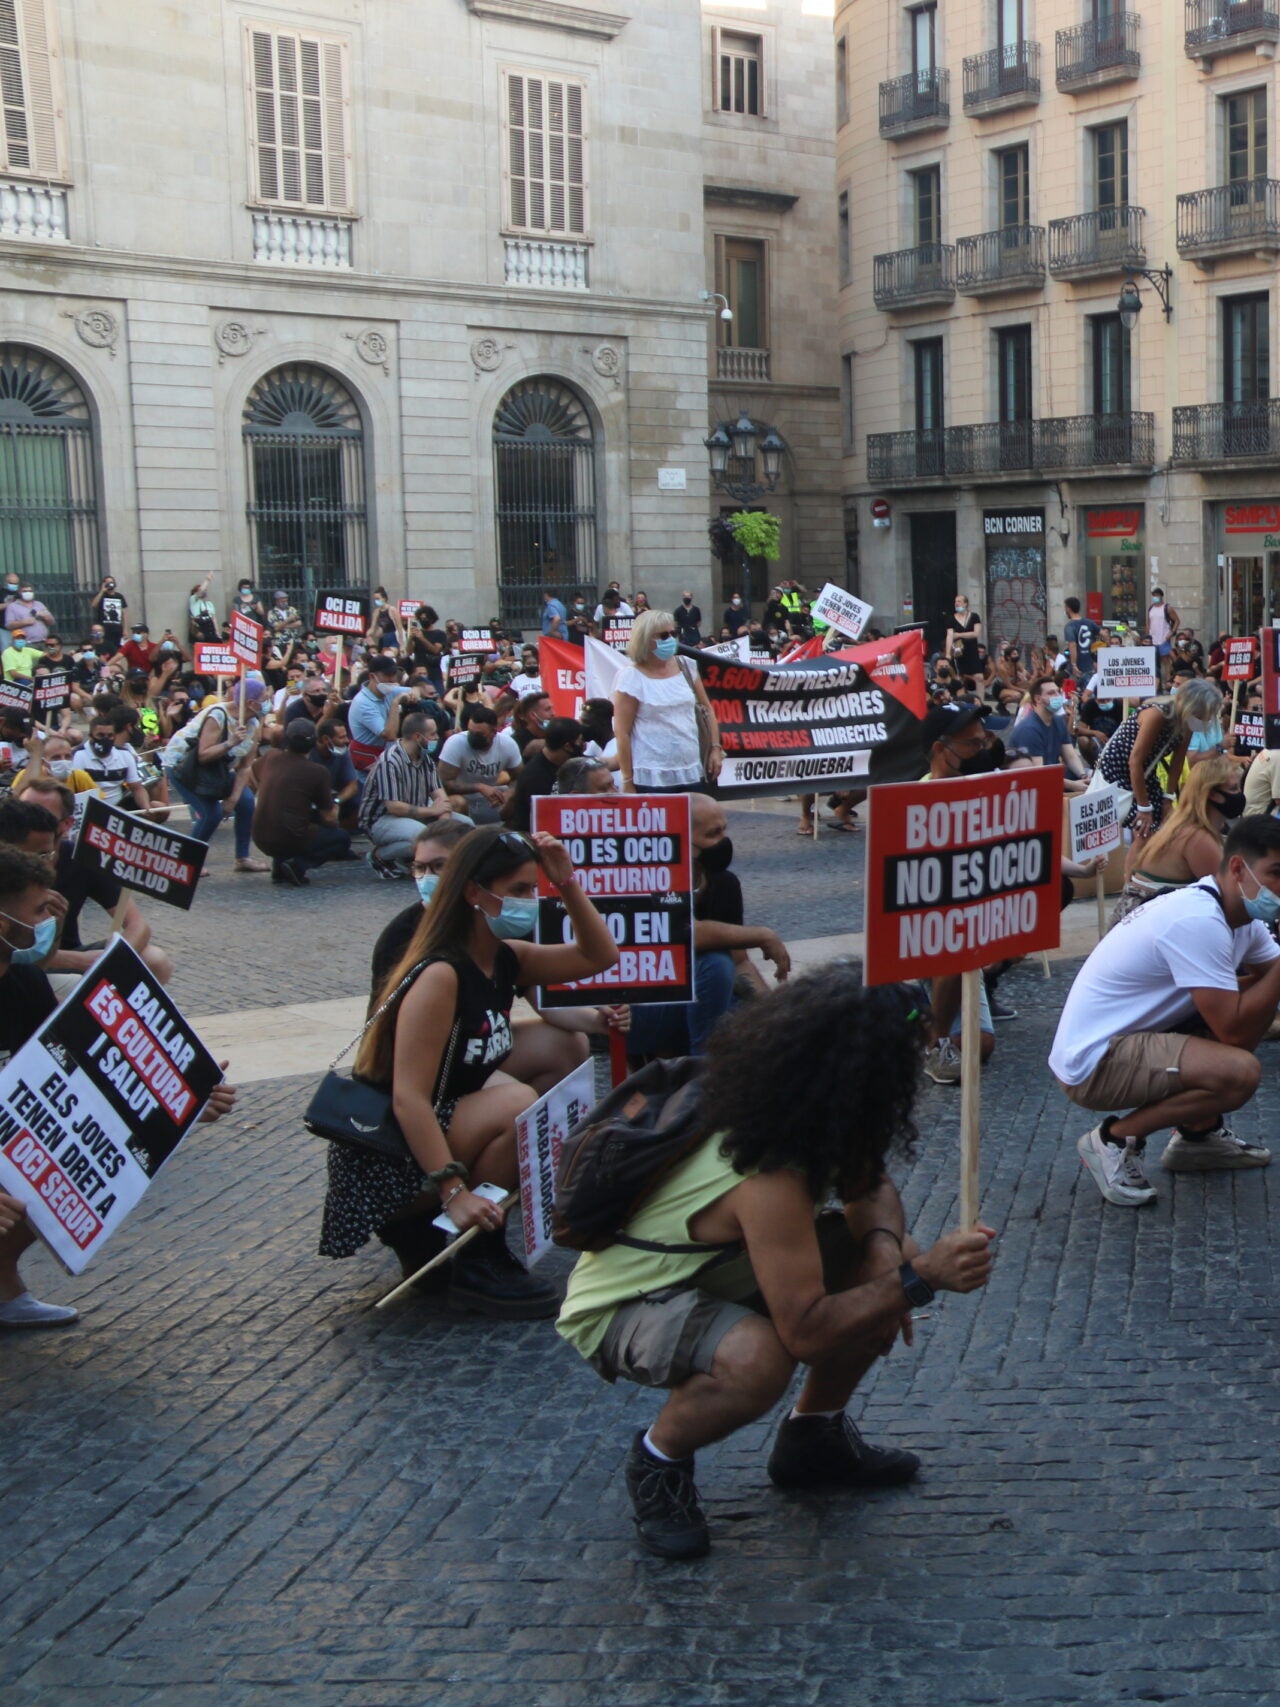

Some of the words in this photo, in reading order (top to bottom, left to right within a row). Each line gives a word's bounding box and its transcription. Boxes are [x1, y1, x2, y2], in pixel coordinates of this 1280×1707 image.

[985, 517, 1003, 534] BCN
[1006, 516, 1043, 533] CORNER
[325, 597, 344, 612] OCI
[345, 600, 361, 615] EN
[822, 597, 841, 612] TENEN
[841, 608, 857, 621] DRET
[831, 592, 843, 603] ELS
[842, 599, 862, 614] JOVES
[320, 611, 362, 631] FALLIDA
[462, 630, 479, 639] OCIO
[480, 630, 491, 639] EN
[610, 619, 618, 629] EL
[462, 640, 494, 650] QUIEBRA
[605, 630, 612, 640] ES
[455, 659, 461, 667] EL
[462, 657, 477, 667] BAILE
[1103, 668, 1123, 676] TIENEN
[1125, 667, 1150, 676] DERECHO
[1108, 658, 1119, 667] LOS
[42, 679, 49, 688] EL
[764, 665, 859, 691] EMPRESAS
[36, 689, 45, 699] ES
[745, 690, 885, 724] TRABAJADORES
[1234, 724, 1244, 733] ES
[1241, 714, 1250, 724] EL
[721, 732, 739, 750] DE
[741, 730, 810, 750] EMPRESAS
[810, 722, 888, 746] INDIRECTAS
[734, 755, 854, 781] #OCIOENQUIEBRA
[560, 801, 667, 834] BOTELLÓN
[906, 780, 1037, 850] BOTELLÓN
[1080, 803, 1094, 819] ELS
[1095, 795, 1114, 815] JOVES
[107, 815, 126, 839] EL
[130, 826, 182, 859] BAILE
[1075, 817, 1098, 837] TENEN
[1099, 810, 1114, 828] DRET
[89, 826, 111, 849] ES
[113, 839, 189, 882] CULTURA
[591, 838, 618, 863] ES
[624, 836, 673, 862] OCIO
[1076, 837, 1086, 852] UN
[1087, 833, 1100, 849] OCI
[98, 850, 112, 869] Y
[112, 860, 170, 893] SALUD
[573, 865, 671, 894] OCTURNO
[896, 857, 942, 905] NO
[952, 850, 984, 899] ES
[988, 838, 1043, 890] OCIO
[634, 911, 670, 944] EN
[899, 890, 1037, 960] NOCTURNO
[127, 981, 196, 1070] BALLAR
[47, 1041, 67, 1069] FARRA
[90, 983, 124, 1028] ÉS
[114, 1016, 187, 1120] CULTURA
[87, 1031, 108, 1057] I
[99, 1045, 159, 1122] SALUT
[39, 1071, 79, 1119] ELS
[71, 1113, 127, 1179] JOVES
[7, 1078, 68, 1153] TENEN
[59, 1142, 107, 1201] DRET
[95, 1193, 117, 1220] A
[518, 1119, 529, 1163] MILES
[520, 1164, 530, 1184] DE
[536, 1101, 553, 1241] TRABAJADORES
[11, 1136, 50, 1182] OCI
[41, 1170, 98, 1242] SEGUR
[522, 1184, 537, 1255] EMPRESAS
